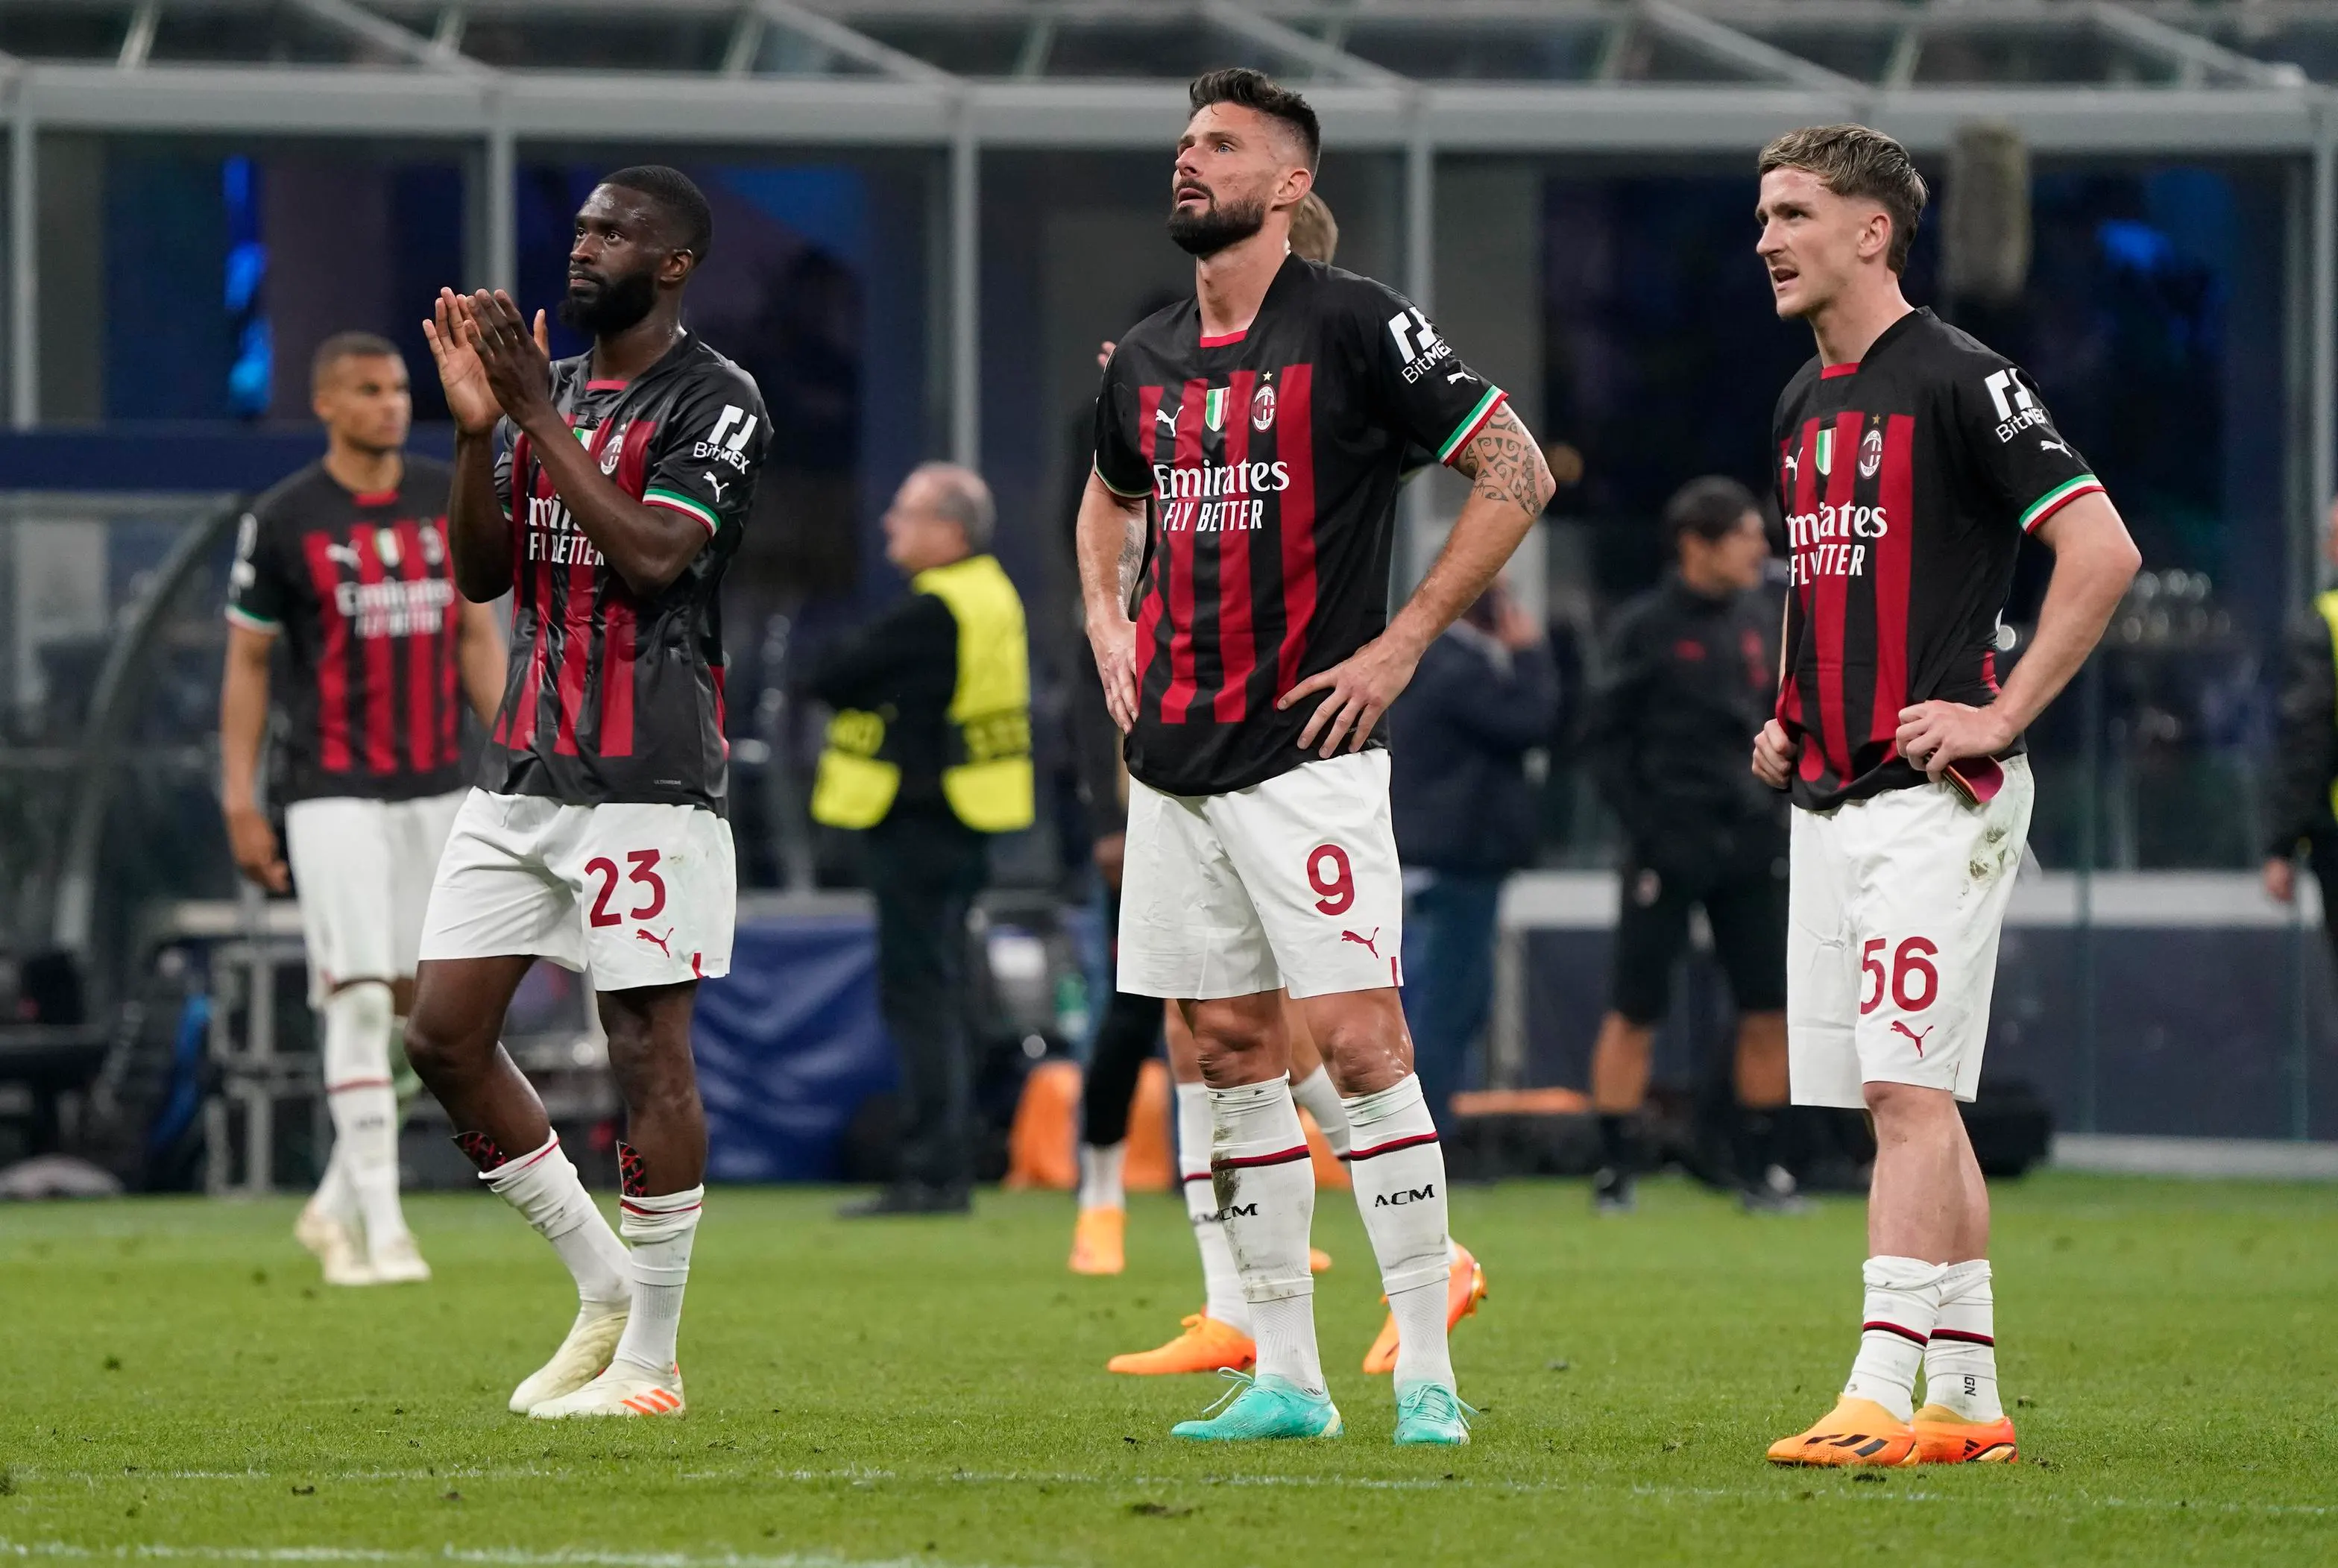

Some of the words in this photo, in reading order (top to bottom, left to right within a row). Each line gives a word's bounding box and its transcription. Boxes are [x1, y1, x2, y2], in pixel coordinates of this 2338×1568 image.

[1402, 339, 1453, 384] BitME
[1153, 458, 1291, 500] Emirates
[1163, 502, 1195, 532] FLY
[1196, 499, 1264, 532] BETTER
[1816, 544, 1866, 576] TTER
[584, 848, 666, 928] 23
[1307, 844, 1355, 916] 9
[1860, 936, 1939, 1016] 56
